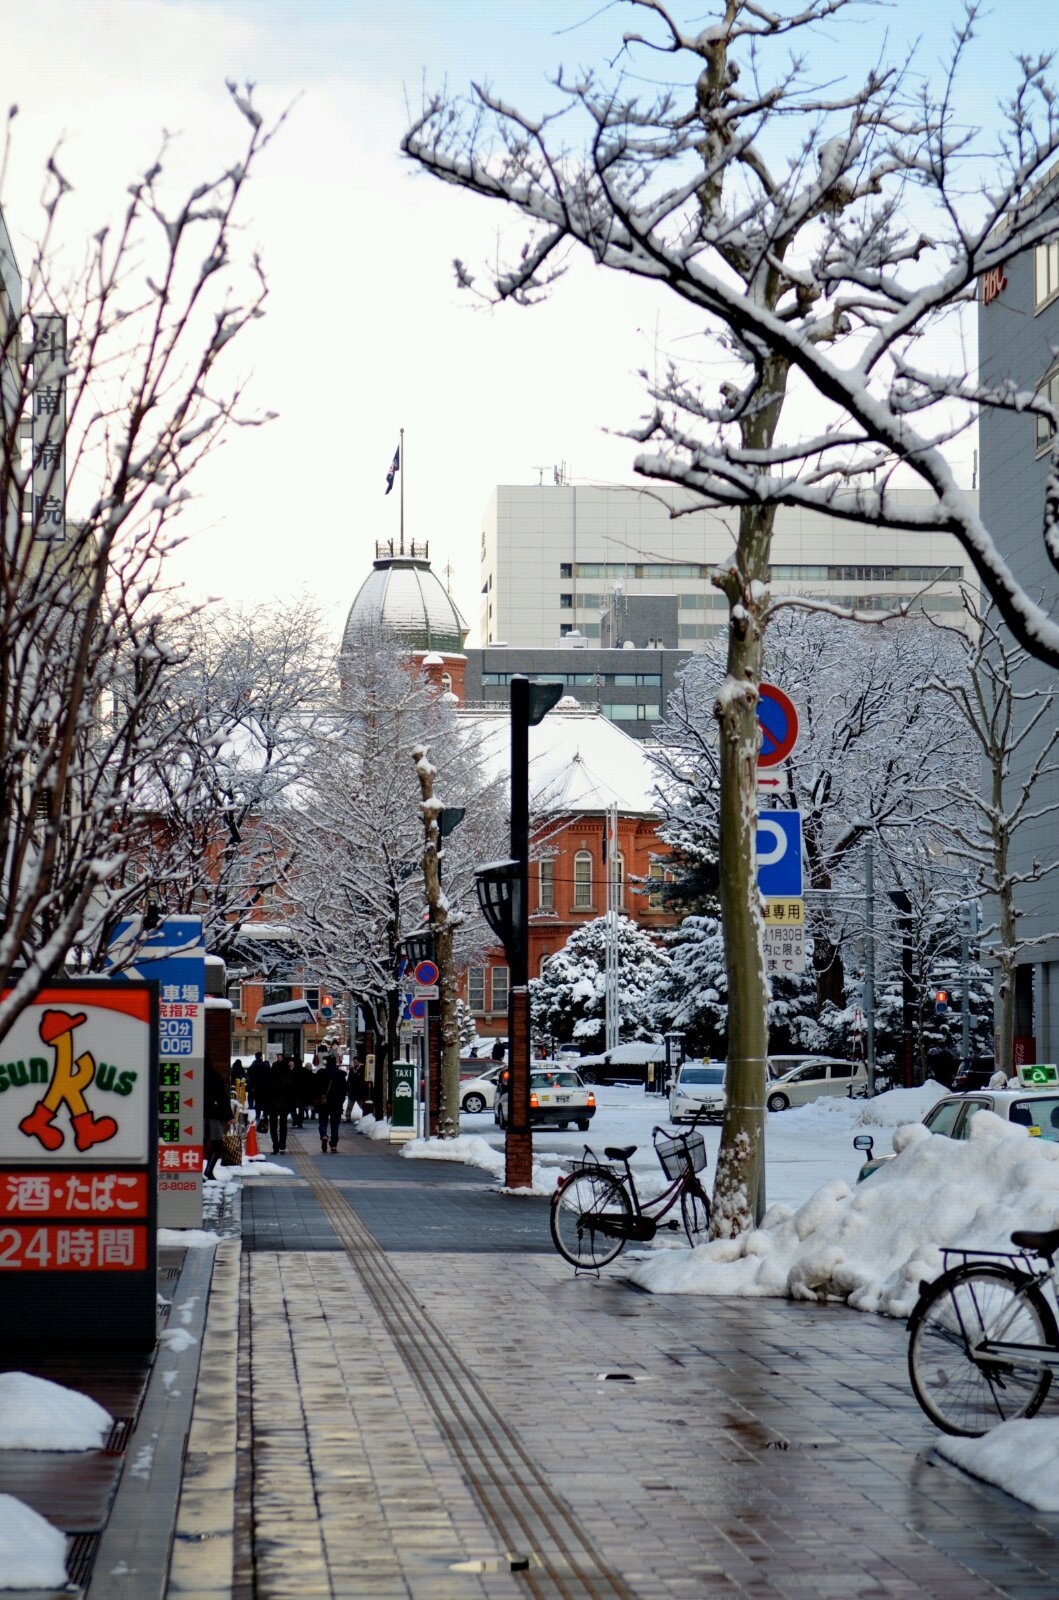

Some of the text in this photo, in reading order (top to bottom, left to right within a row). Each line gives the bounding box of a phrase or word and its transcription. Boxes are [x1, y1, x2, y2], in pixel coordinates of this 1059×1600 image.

[767, 959, 793, 971] まで
[160, 984, 200, 1002] 車場
[394, 1069, 412, 1078] TAXI
[159, 1150, 200, 1168] 集中
[6, 1175, 139, 1212] 酒・たばこ
[0, 1227, 135, 1267] 24時間
